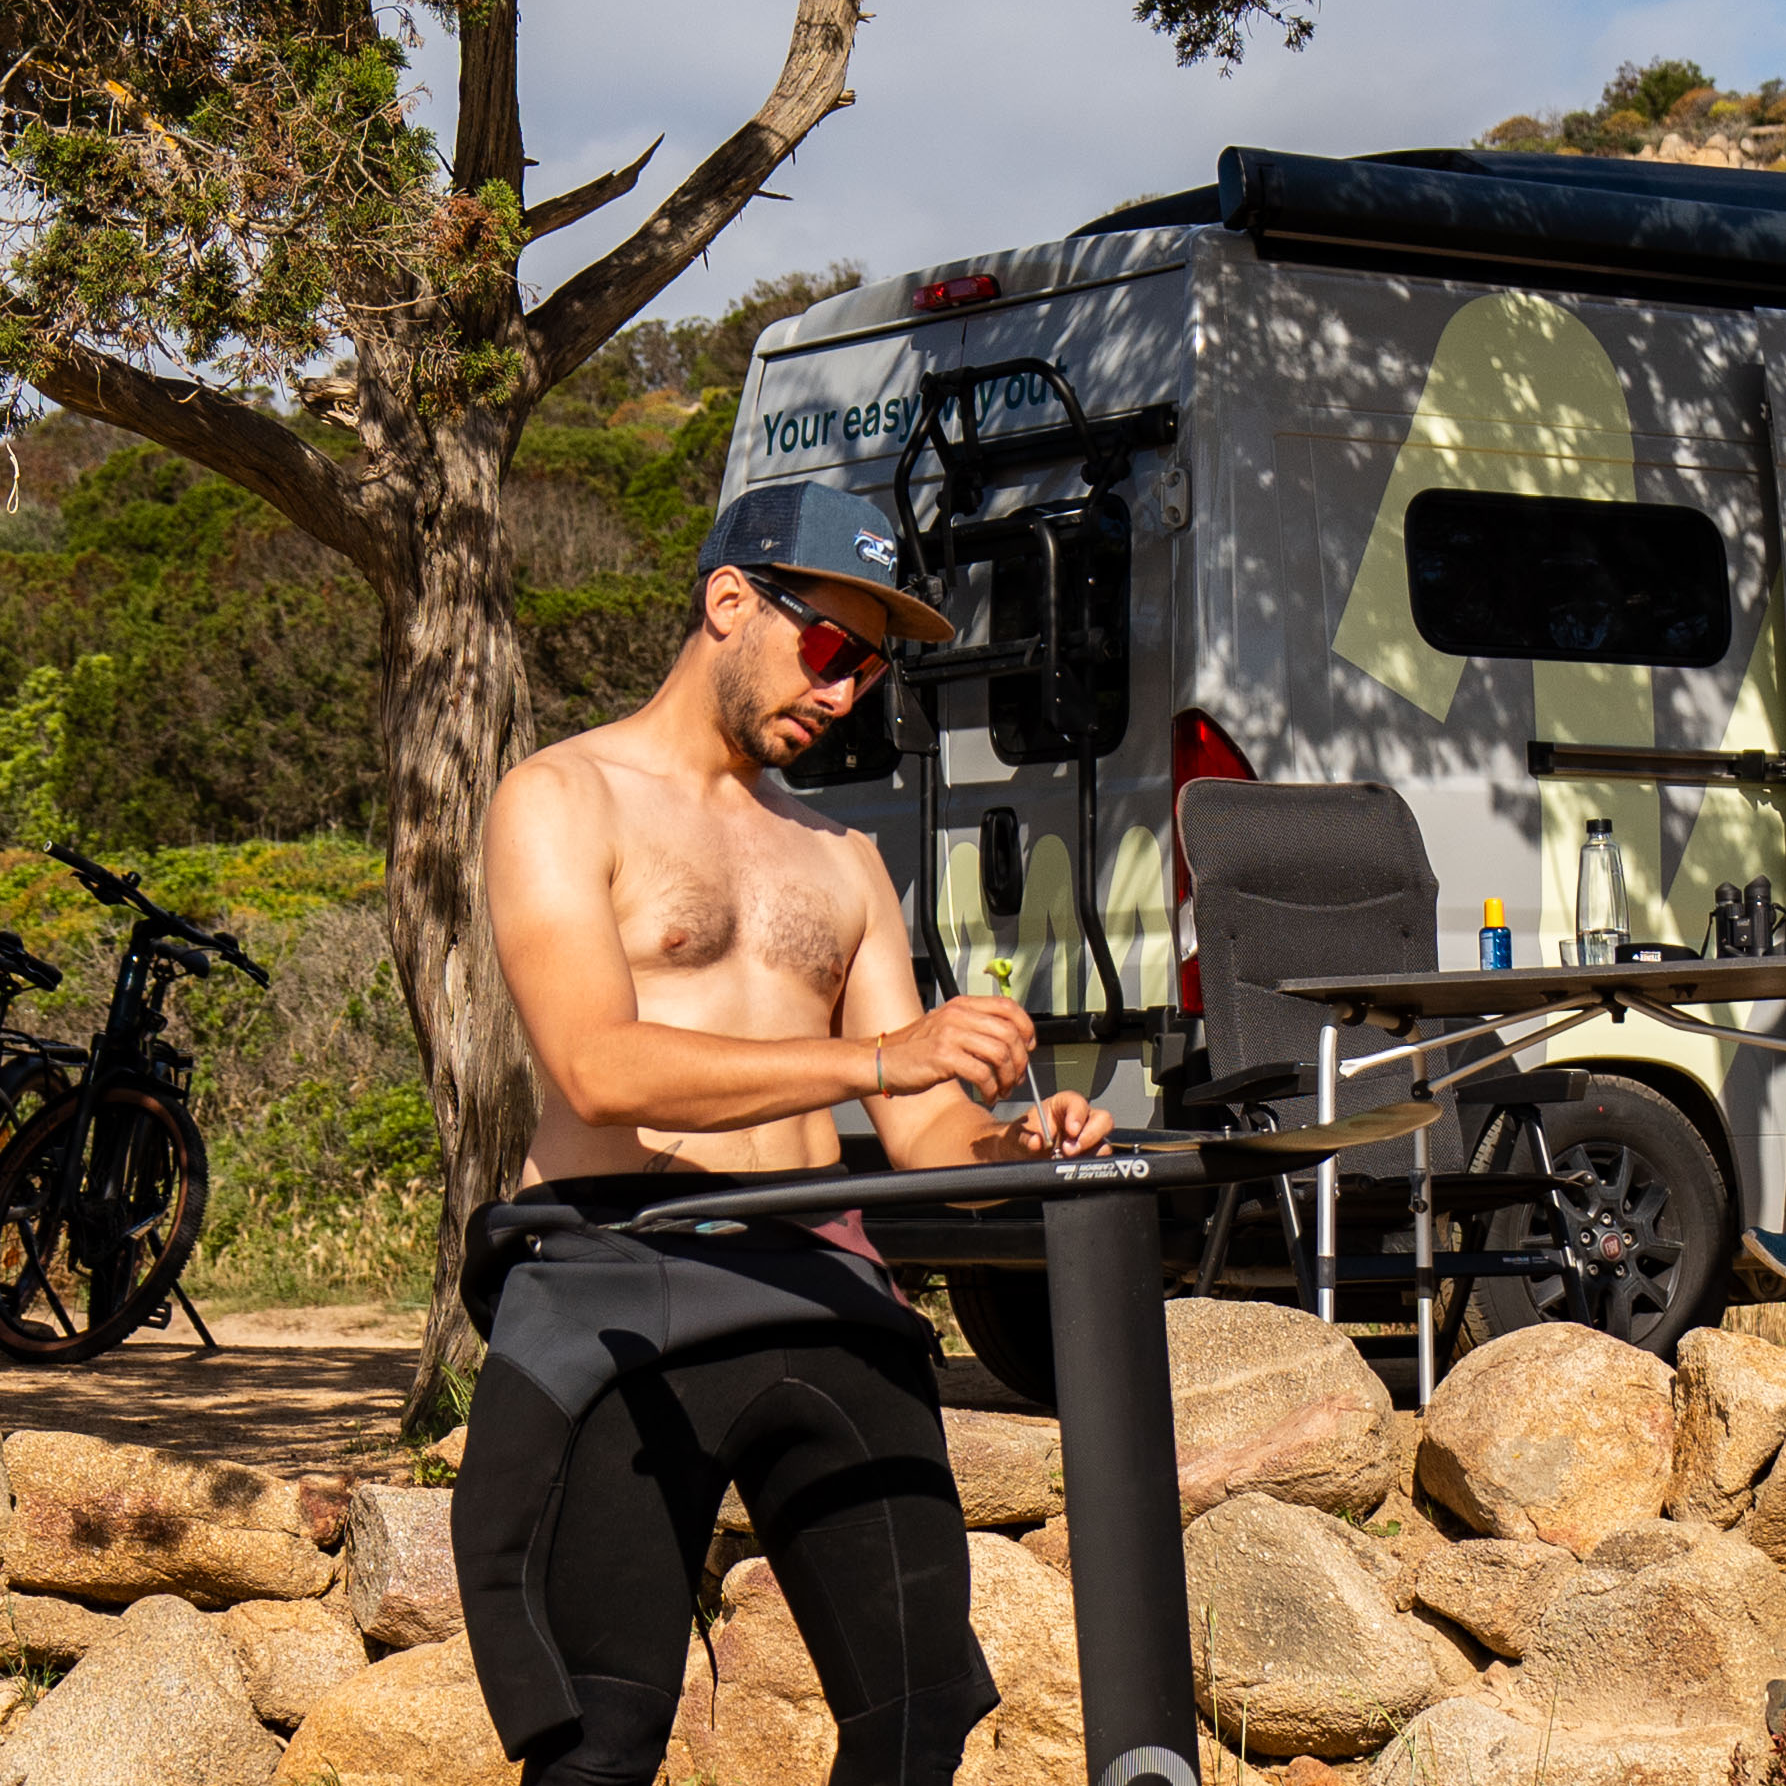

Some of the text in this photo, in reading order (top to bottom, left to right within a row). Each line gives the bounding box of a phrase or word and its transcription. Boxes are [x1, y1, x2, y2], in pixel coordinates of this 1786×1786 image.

[763, 409, 837, 456] Your
[842, 394, 921, 443] easy
[1115, 1158, 1150, 1179] GA
